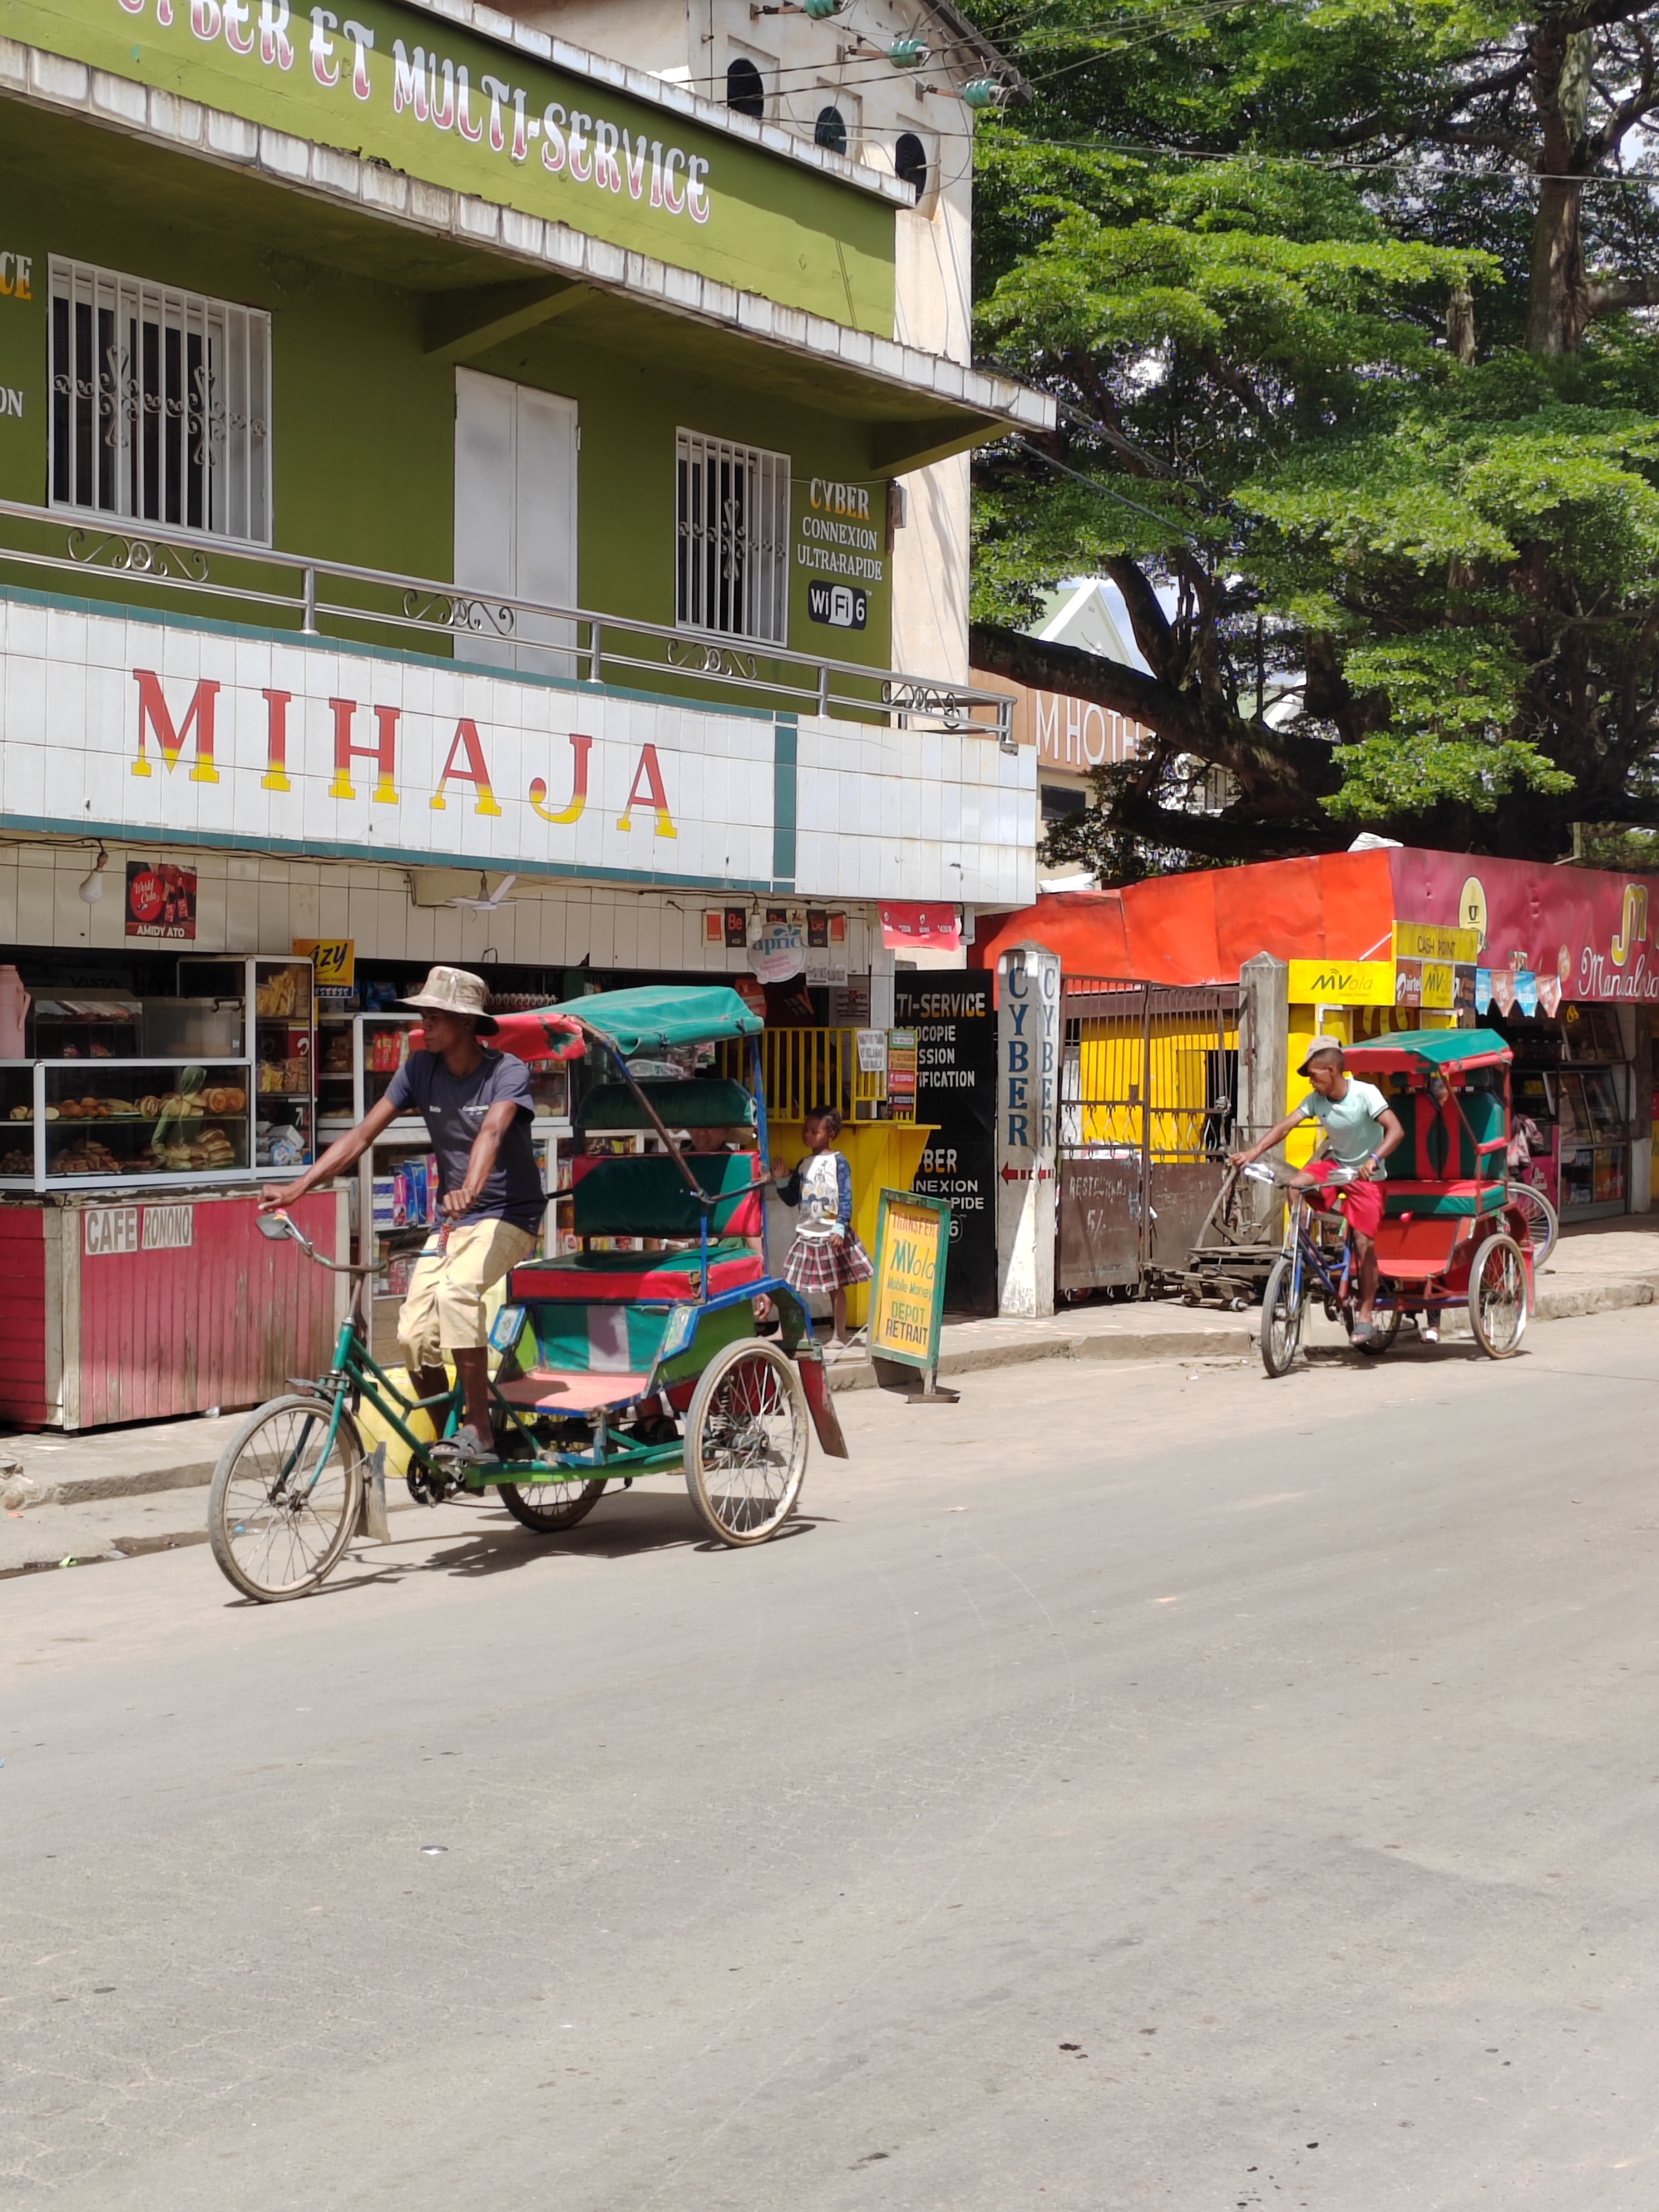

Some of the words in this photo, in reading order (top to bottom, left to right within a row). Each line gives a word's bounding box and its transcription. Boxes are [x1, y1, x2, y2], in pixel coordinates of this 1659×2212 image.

[119, 0, 294, 70] BER
[309, 6, 374, 100] ET
[392, 38, 712, 224] MULTI-SERVICE
[810, 477, 871, 521] CYBER
[802, 516, 878, 551] CONNEXION
[855, 598, 865, 622] 6
[131, 669, 677, 839] MIHAJA
[137, 925, 165, 936] AMIDY
[166, 927, 185, 938] ATO
[729, 913, 743, 930] Be
[1418, 935, 1435, 954] CASH
[1438, 940, 1456, 957] POINT
[1311, 974, 1373, 990] MVola
[895, 993, 986, 1018] TI-SERVICE
[899, 1025, 956, 1042] OCOPIE
[919, 1048, 955, 1064] SSION
[1008, 967, 1029, 1146] CYBER
[1041, 968, 1055, 1147] CYBER
[917, 1070, 975, 1088] IFICATION
[923, 1149, 957, 1174] BER
[948, 1197, 984, 1210] PIDE
[87, 1211, 136, 1253] CAFE
[144, 1206, 190, 1247] RONONO
[892, 1211, 939, 1238] TRANSFER
[891, 1238, 935, 1280] MVola
[887, 1277, 908, 1294] Mobile
[909, 1283, 932, 1301] Money
[891, 1300, 927, 1325] DEPOT
[885, 1318, 929, 1345] RETRAIT
